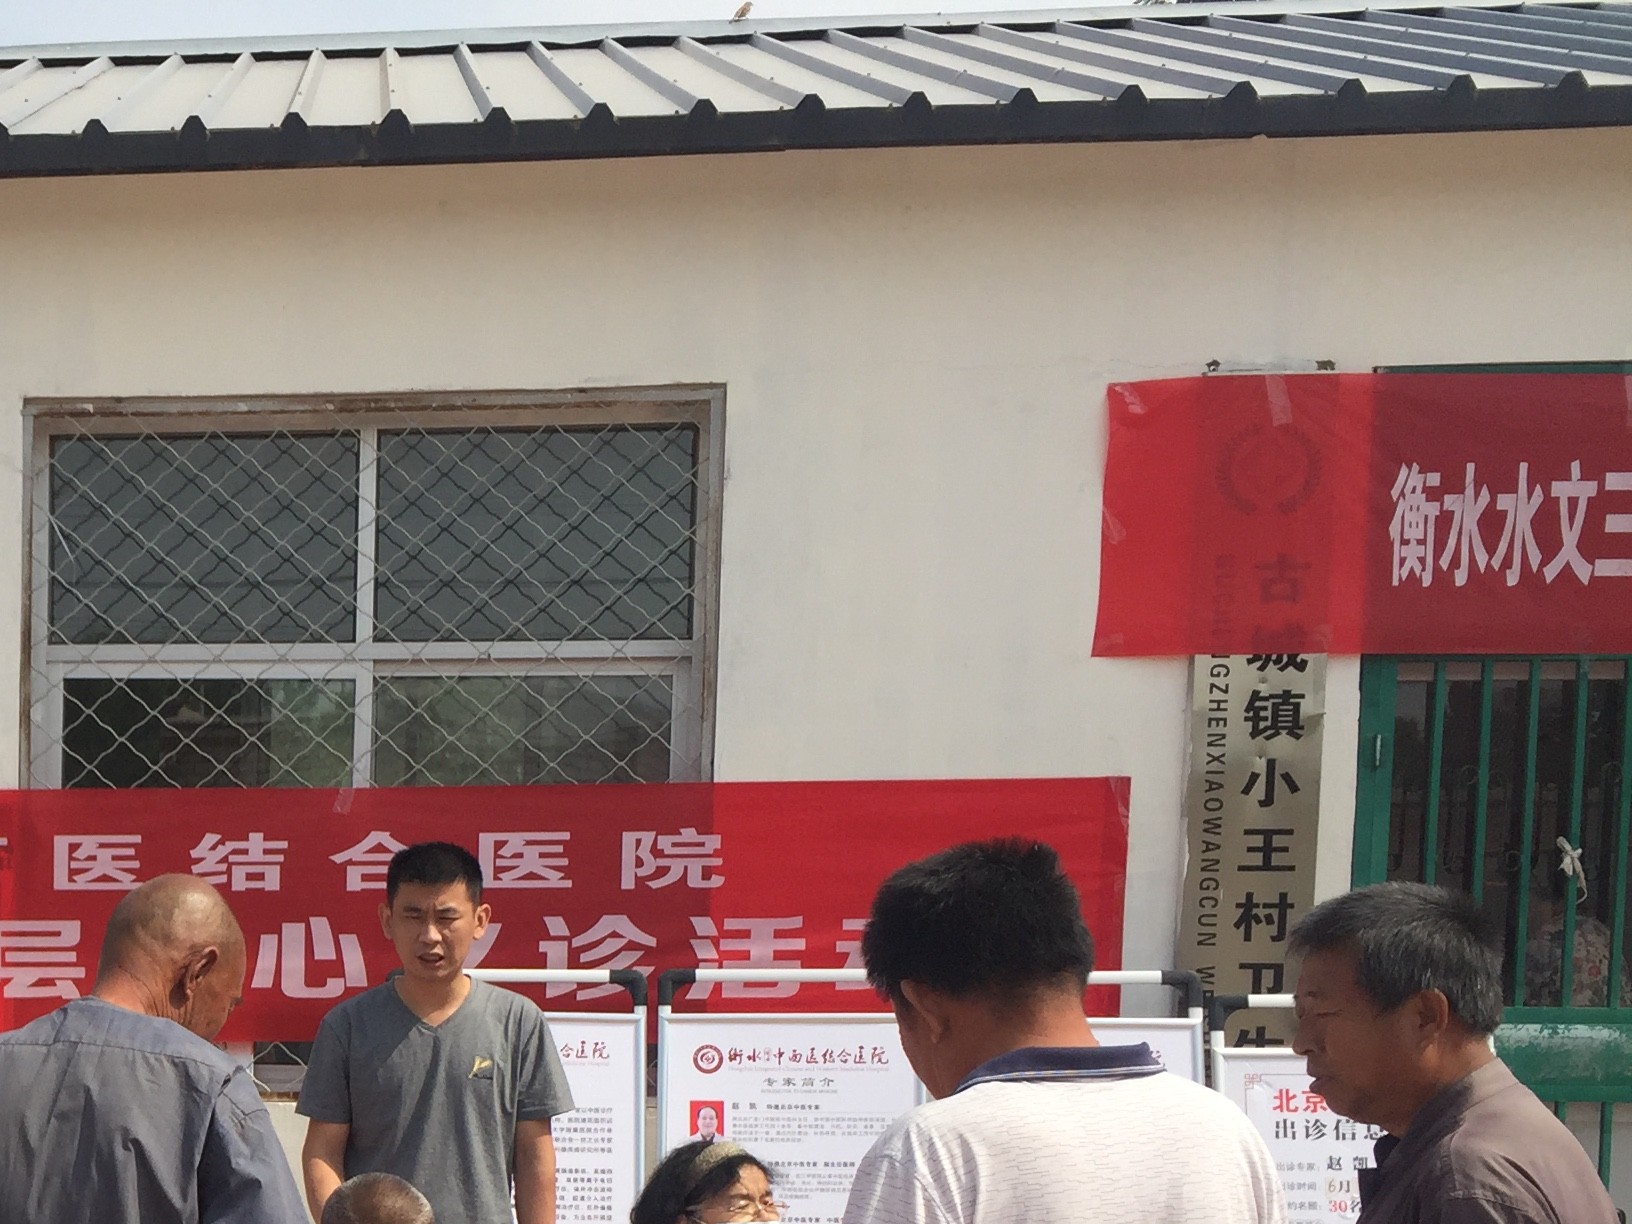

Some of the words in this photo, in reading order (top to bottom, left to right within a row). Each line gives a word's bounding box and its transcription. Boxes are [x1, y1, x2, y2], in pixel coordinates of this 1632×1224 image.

[1388, 459, 1632, 588] 衡水水文三
[1196, 653, 1232, 947] GZHENXIAOWANGCUN
[762, 1077, 835, 1088] 专家简介
[1272, 1088, 1328, 1114] 北京
